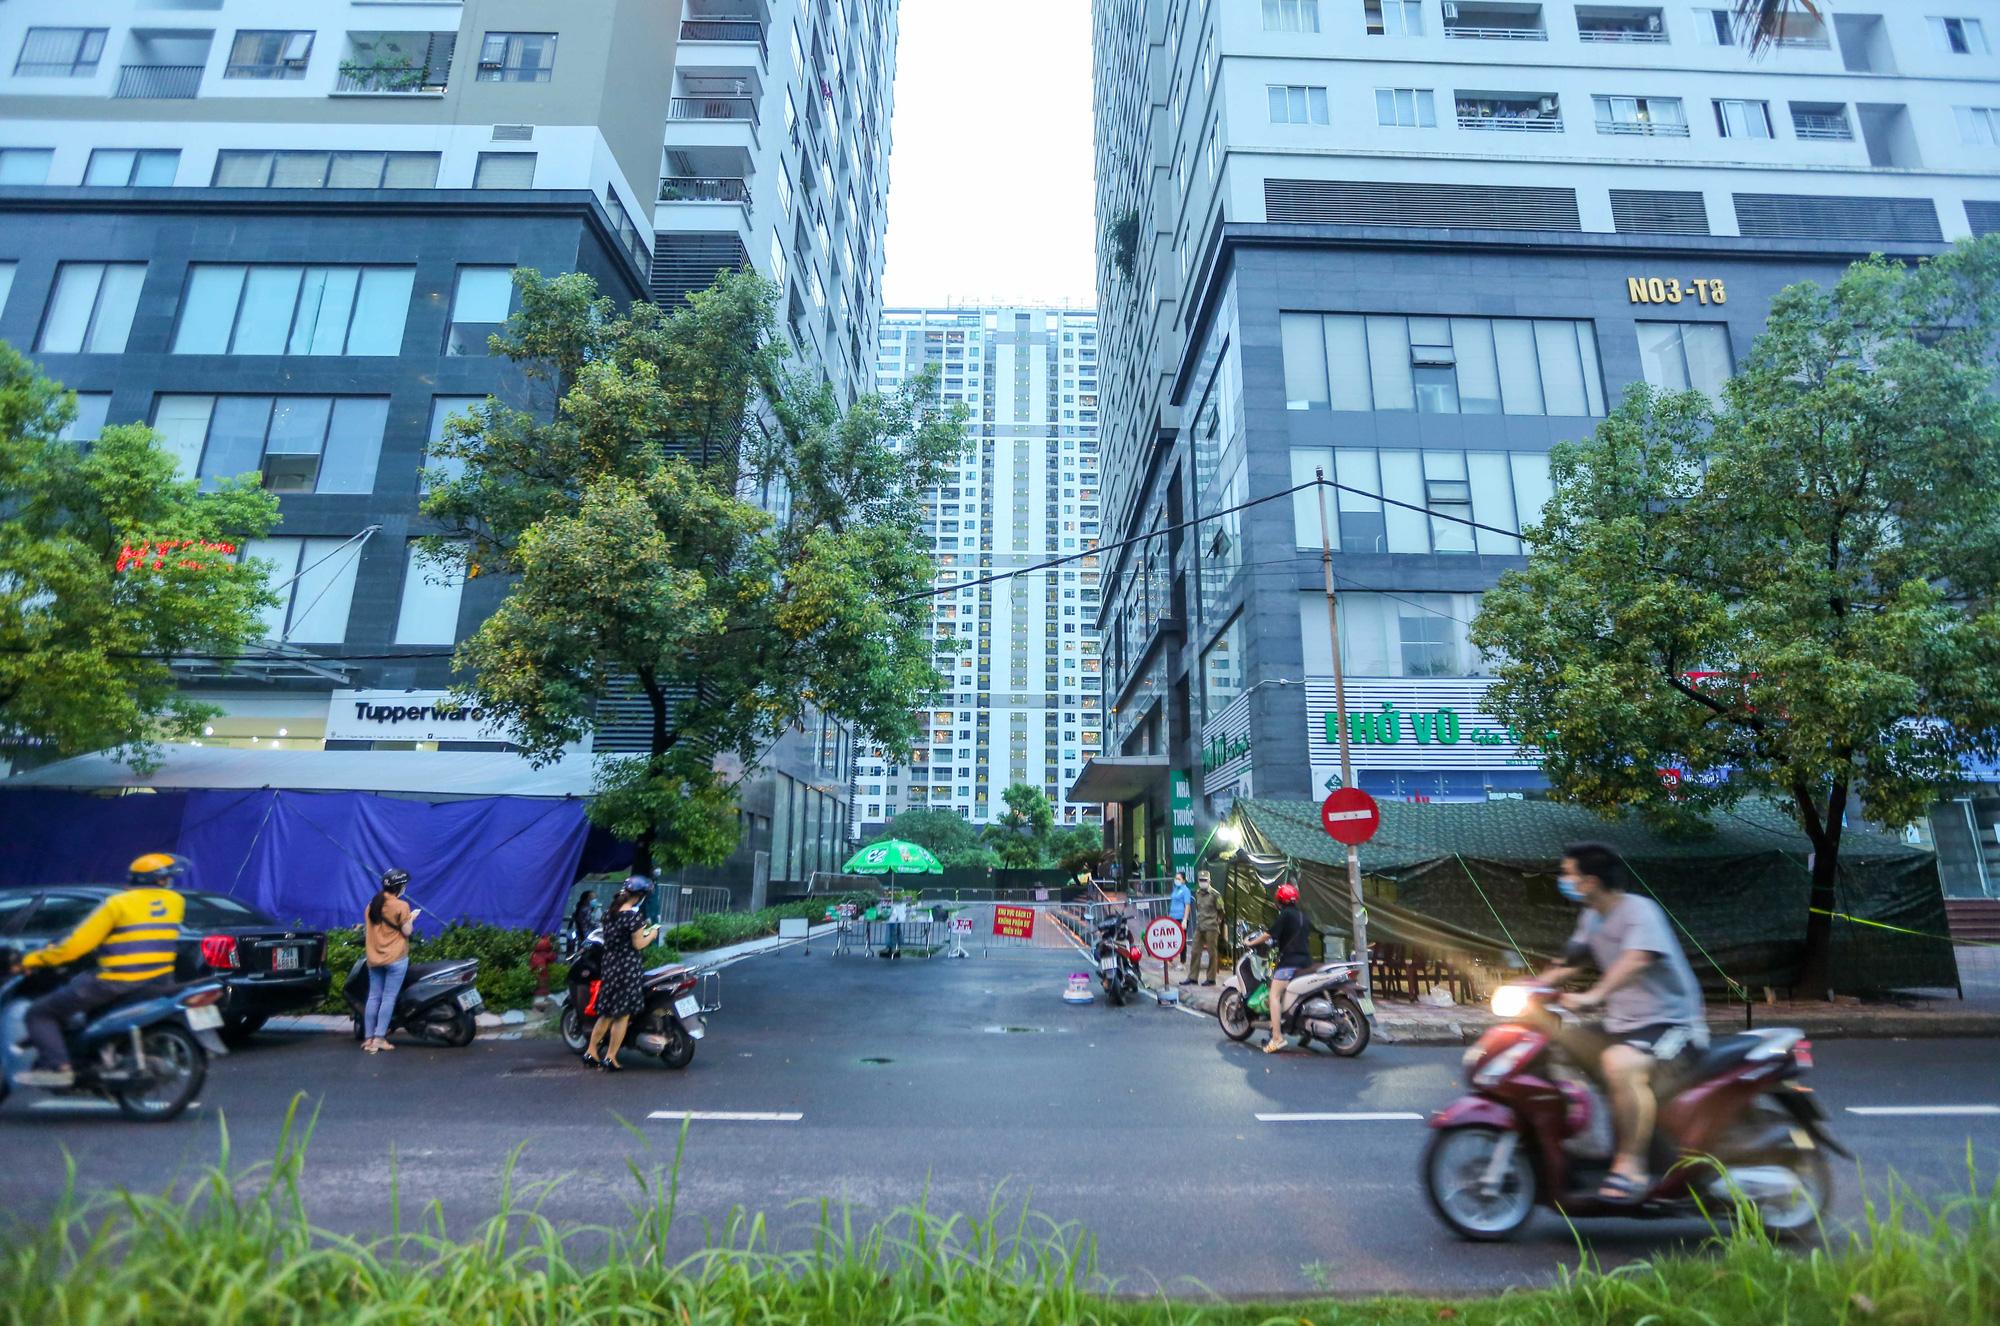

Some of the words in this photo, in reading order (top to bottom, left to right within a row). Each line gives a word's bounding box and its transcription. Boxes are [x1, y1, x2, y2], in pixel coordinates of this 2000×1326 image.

[1324, 700, 1401, 745] PHỞ
[1409, 707, 1460, 744] VŨ
[1176, 779, 1190, 798] NHÀ
[1173, 804, 1194, 826] THUỐC
[1173, 835, 1195, 855] KHÁNH
[1167, 941, 1177, 949] XE
